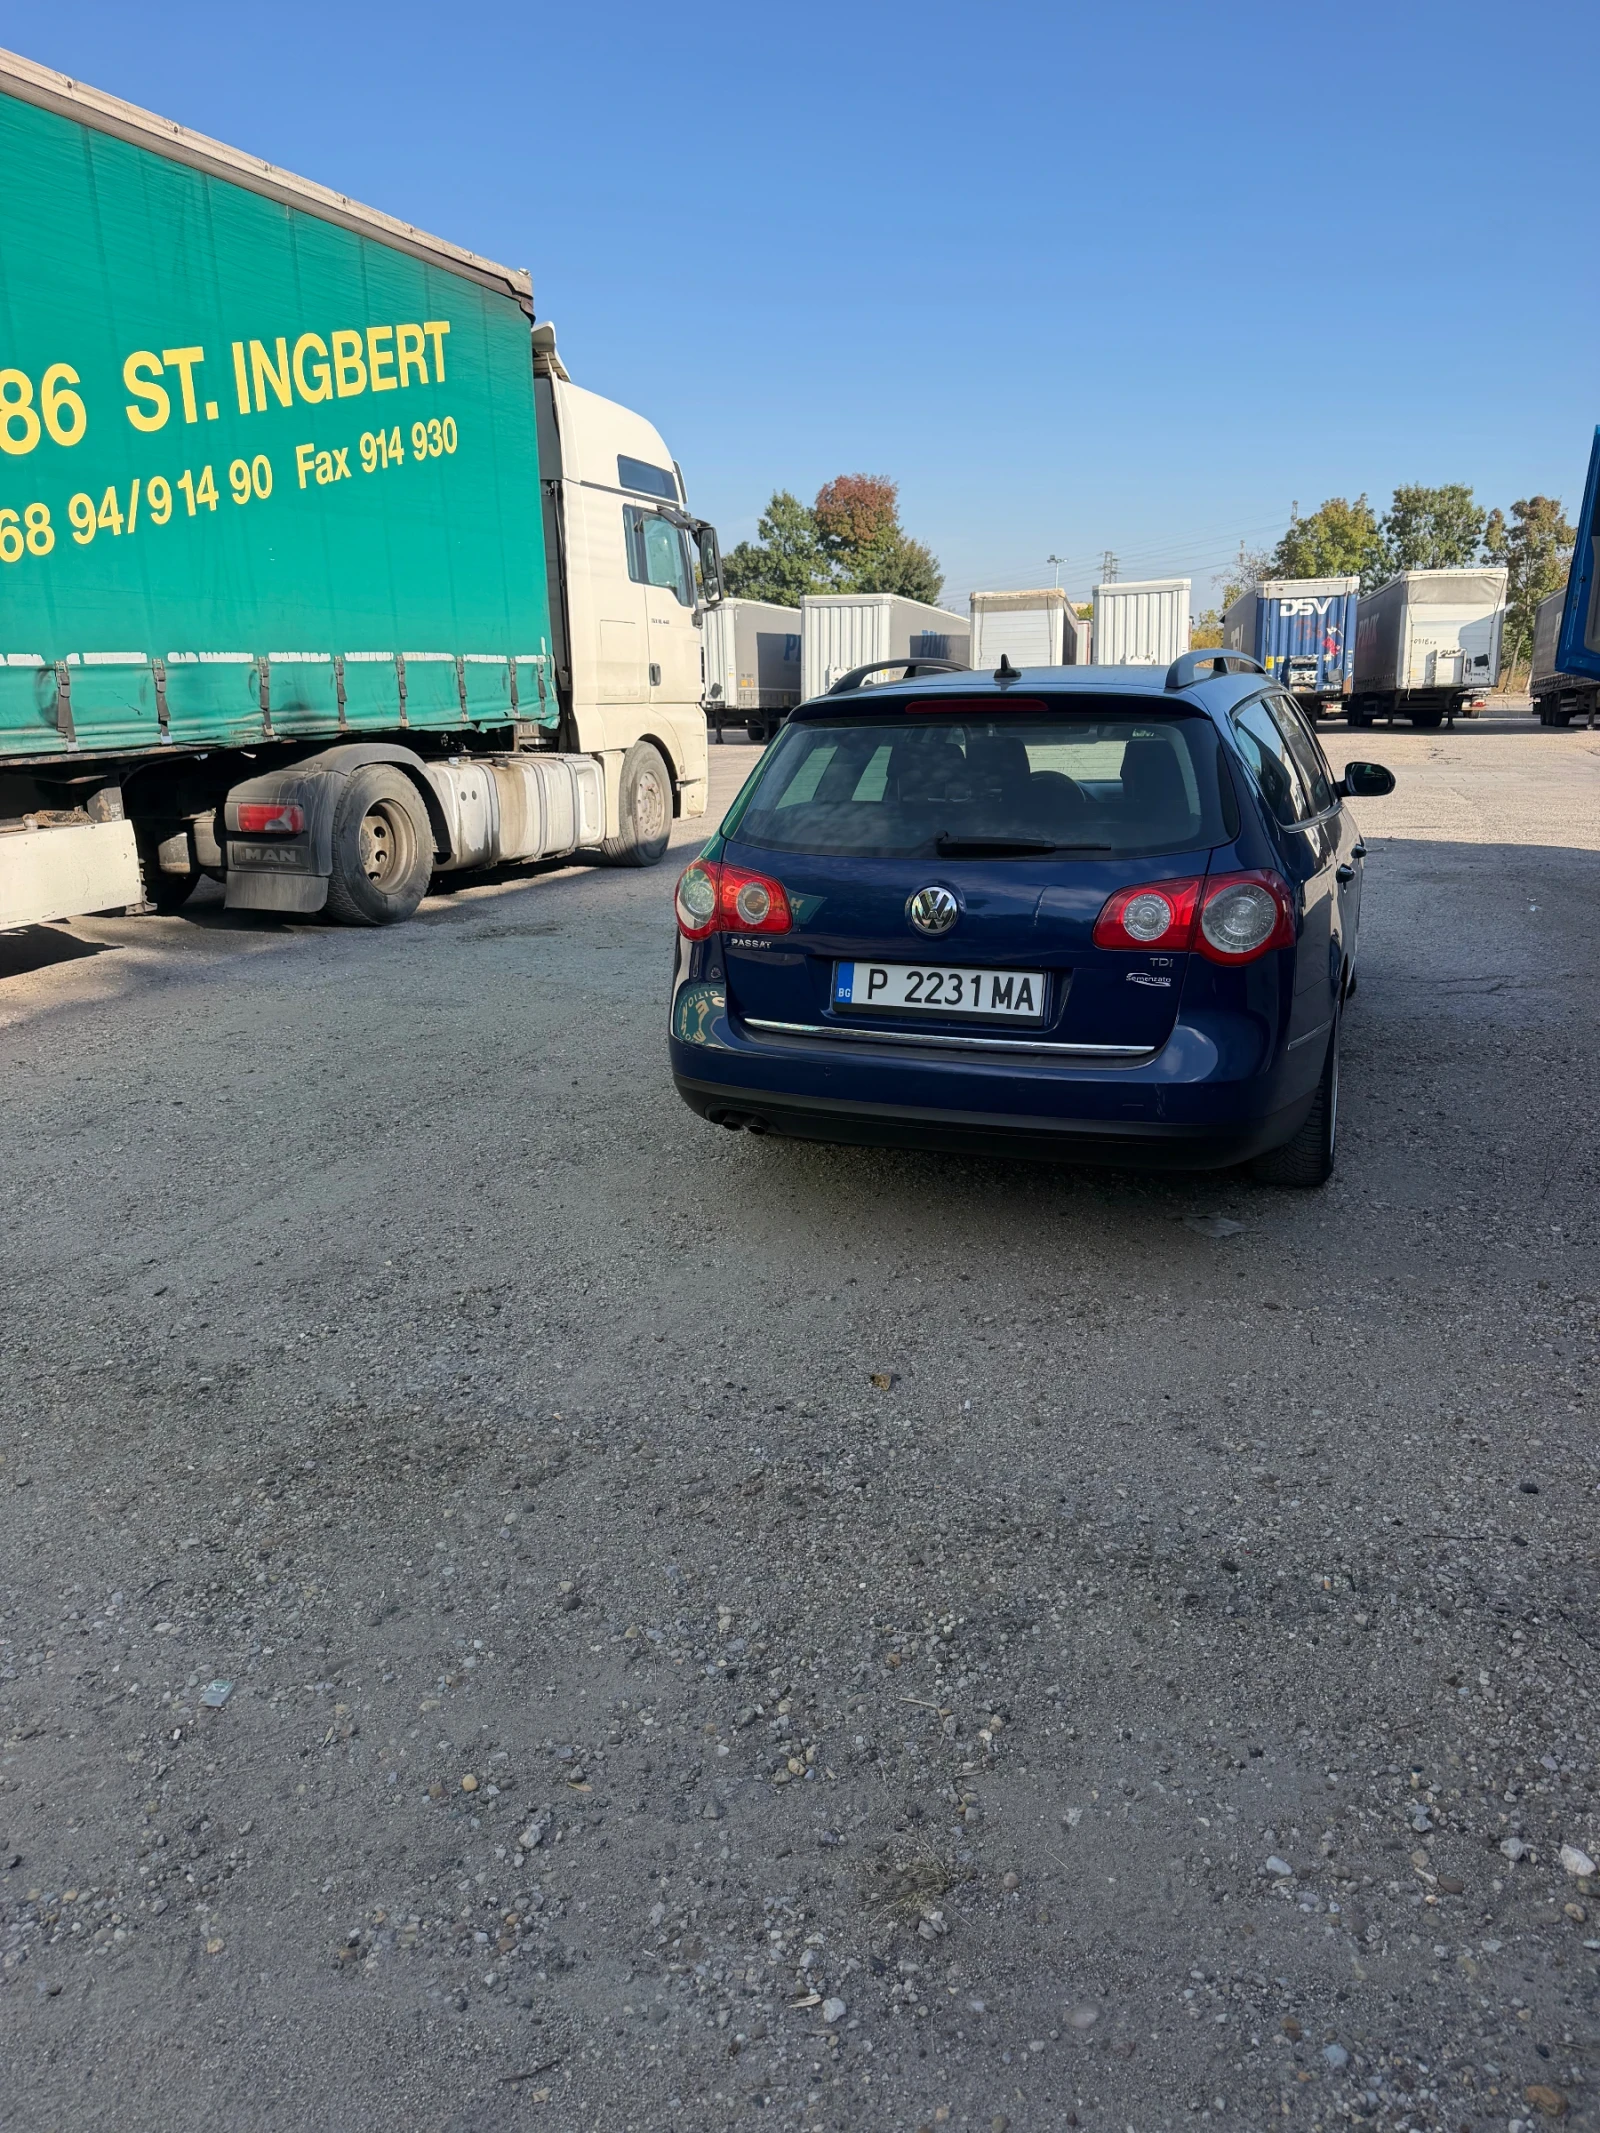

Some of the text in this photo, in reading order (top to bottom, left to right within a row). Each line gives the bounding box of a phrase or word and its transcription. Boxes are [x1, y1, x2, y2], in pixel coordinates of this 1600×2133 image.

[0, 320, 451, 455] 86 ST. INGBERT
[0, 502, 56, 563] 68
[229, 454, 273, 505] 90
[296, 443, 350, 489] Fax
[359, 426, 404, 473] 914
[411, 416, 458, 460] 930
[1280, 597, 1333, 617] DSV
[245, 848, 297, 862] MAN
[731, 938, 772, 949] PASSAT
[1149, 957, 1174, 968] TDI
[838, 987, 851, 998] BG
[867, 968, 1034, 1012] P 2231 MA
